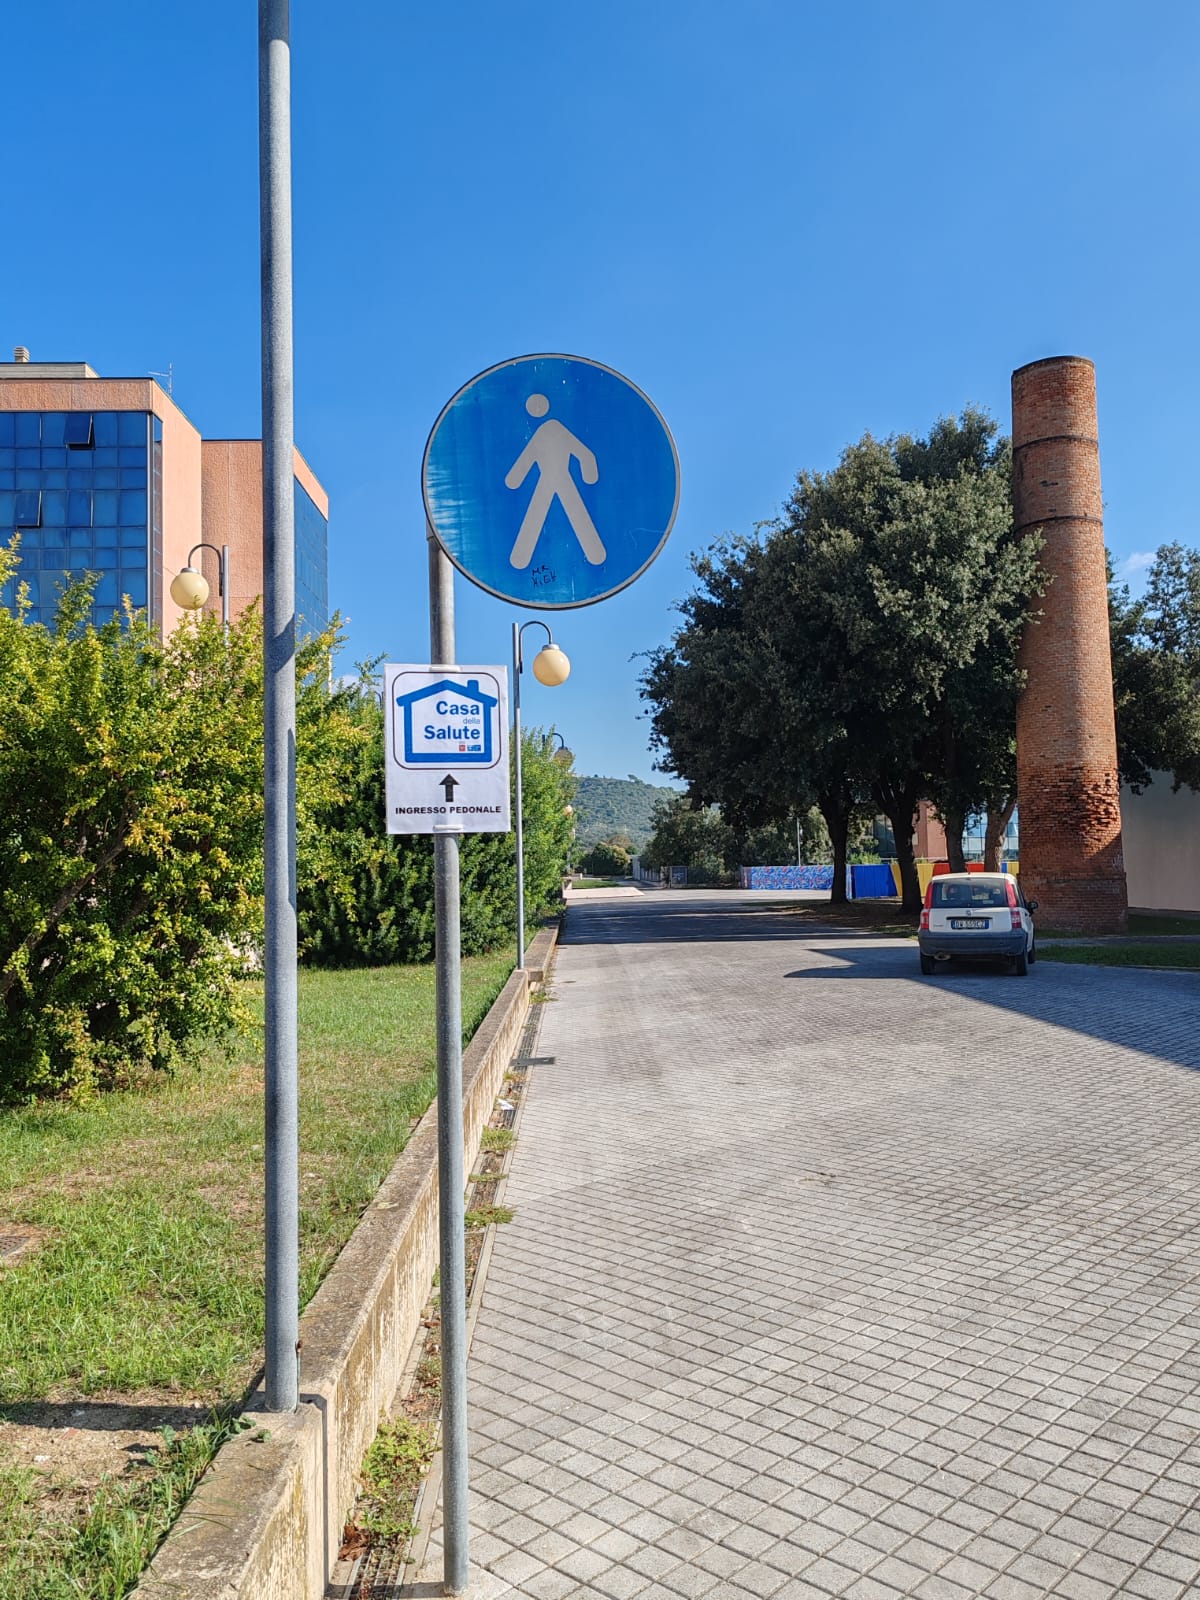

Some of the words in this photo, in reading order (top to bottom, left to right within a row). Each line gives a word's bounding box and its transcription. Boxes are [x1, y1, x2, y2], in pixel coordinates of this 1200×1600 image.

[436, 700, 480, 715] Casa
[424, 725, 480, 740] Salute
[395, 806, 447, 815] INGRESSO
[449, 805, 502, 814] PEDONALE
